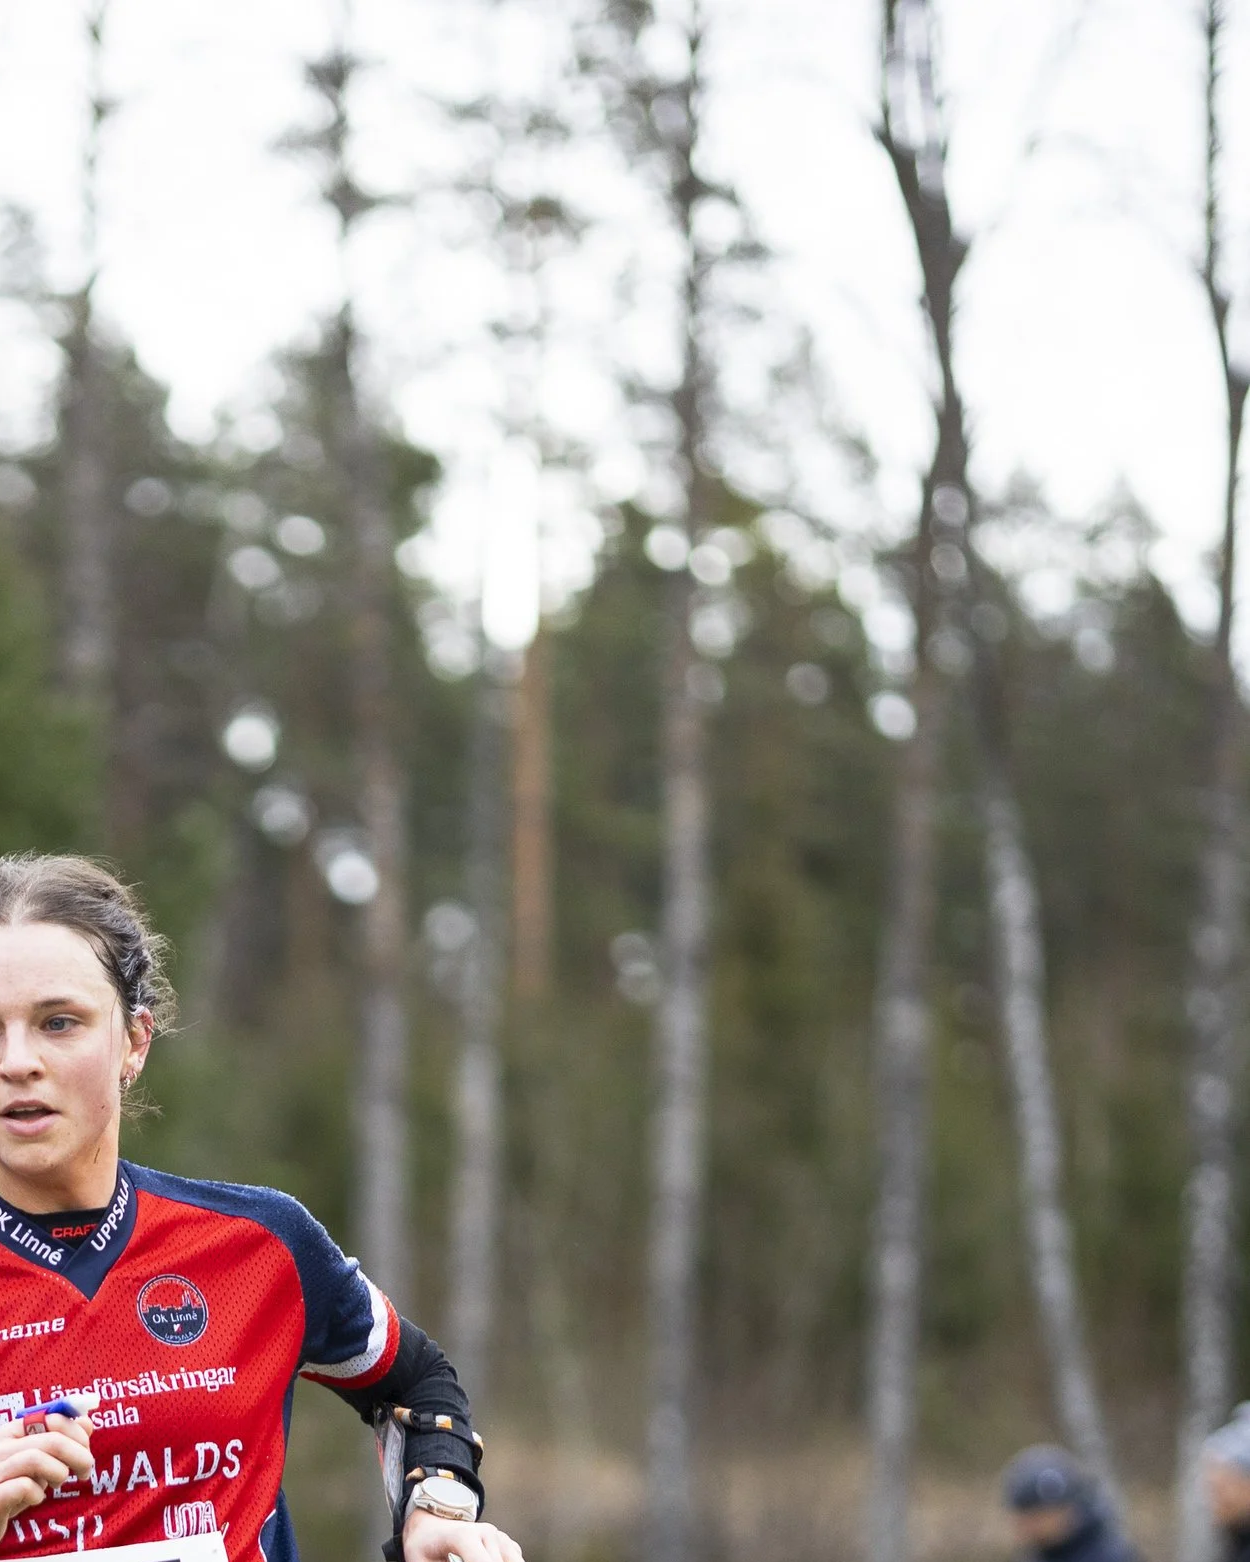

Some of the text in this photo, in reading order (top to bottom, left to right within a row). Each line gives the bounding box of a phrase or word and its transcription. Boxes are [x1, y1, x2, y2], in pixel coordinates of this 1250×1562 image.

[90, 1178, 129, 1251] UPPSALA
[10, 1222, 64, 1266] Linné
[170, 1310, 198, 1323] Linné
[91, 1402, 140, 1430] sala
[53, 1439, 244, 1499] EWALDS
